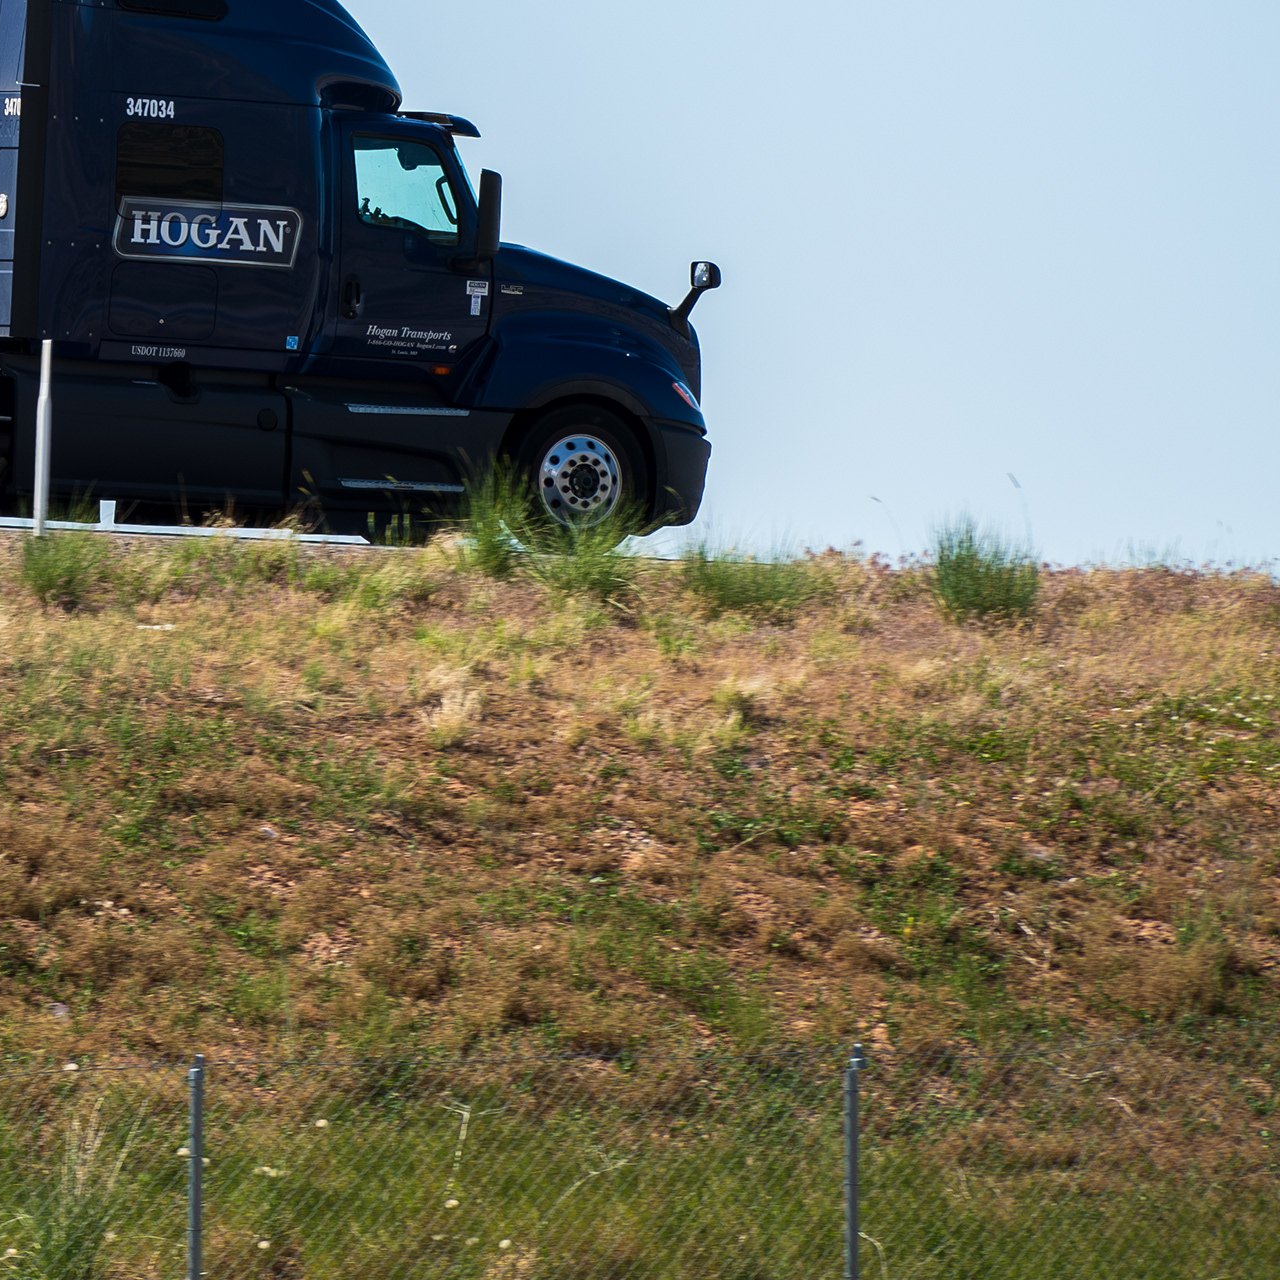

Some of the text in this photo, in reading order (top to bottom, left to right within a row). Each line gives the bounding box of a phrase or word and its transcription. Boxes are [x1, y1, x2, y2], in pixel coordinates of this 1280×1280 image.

[126, 97, 175, 118] 347034
[131, 210, 289, 253] HOGAN
[366, 325, 452, 342] Hogan Transports
[131, 345, 157, 357] USDOT
